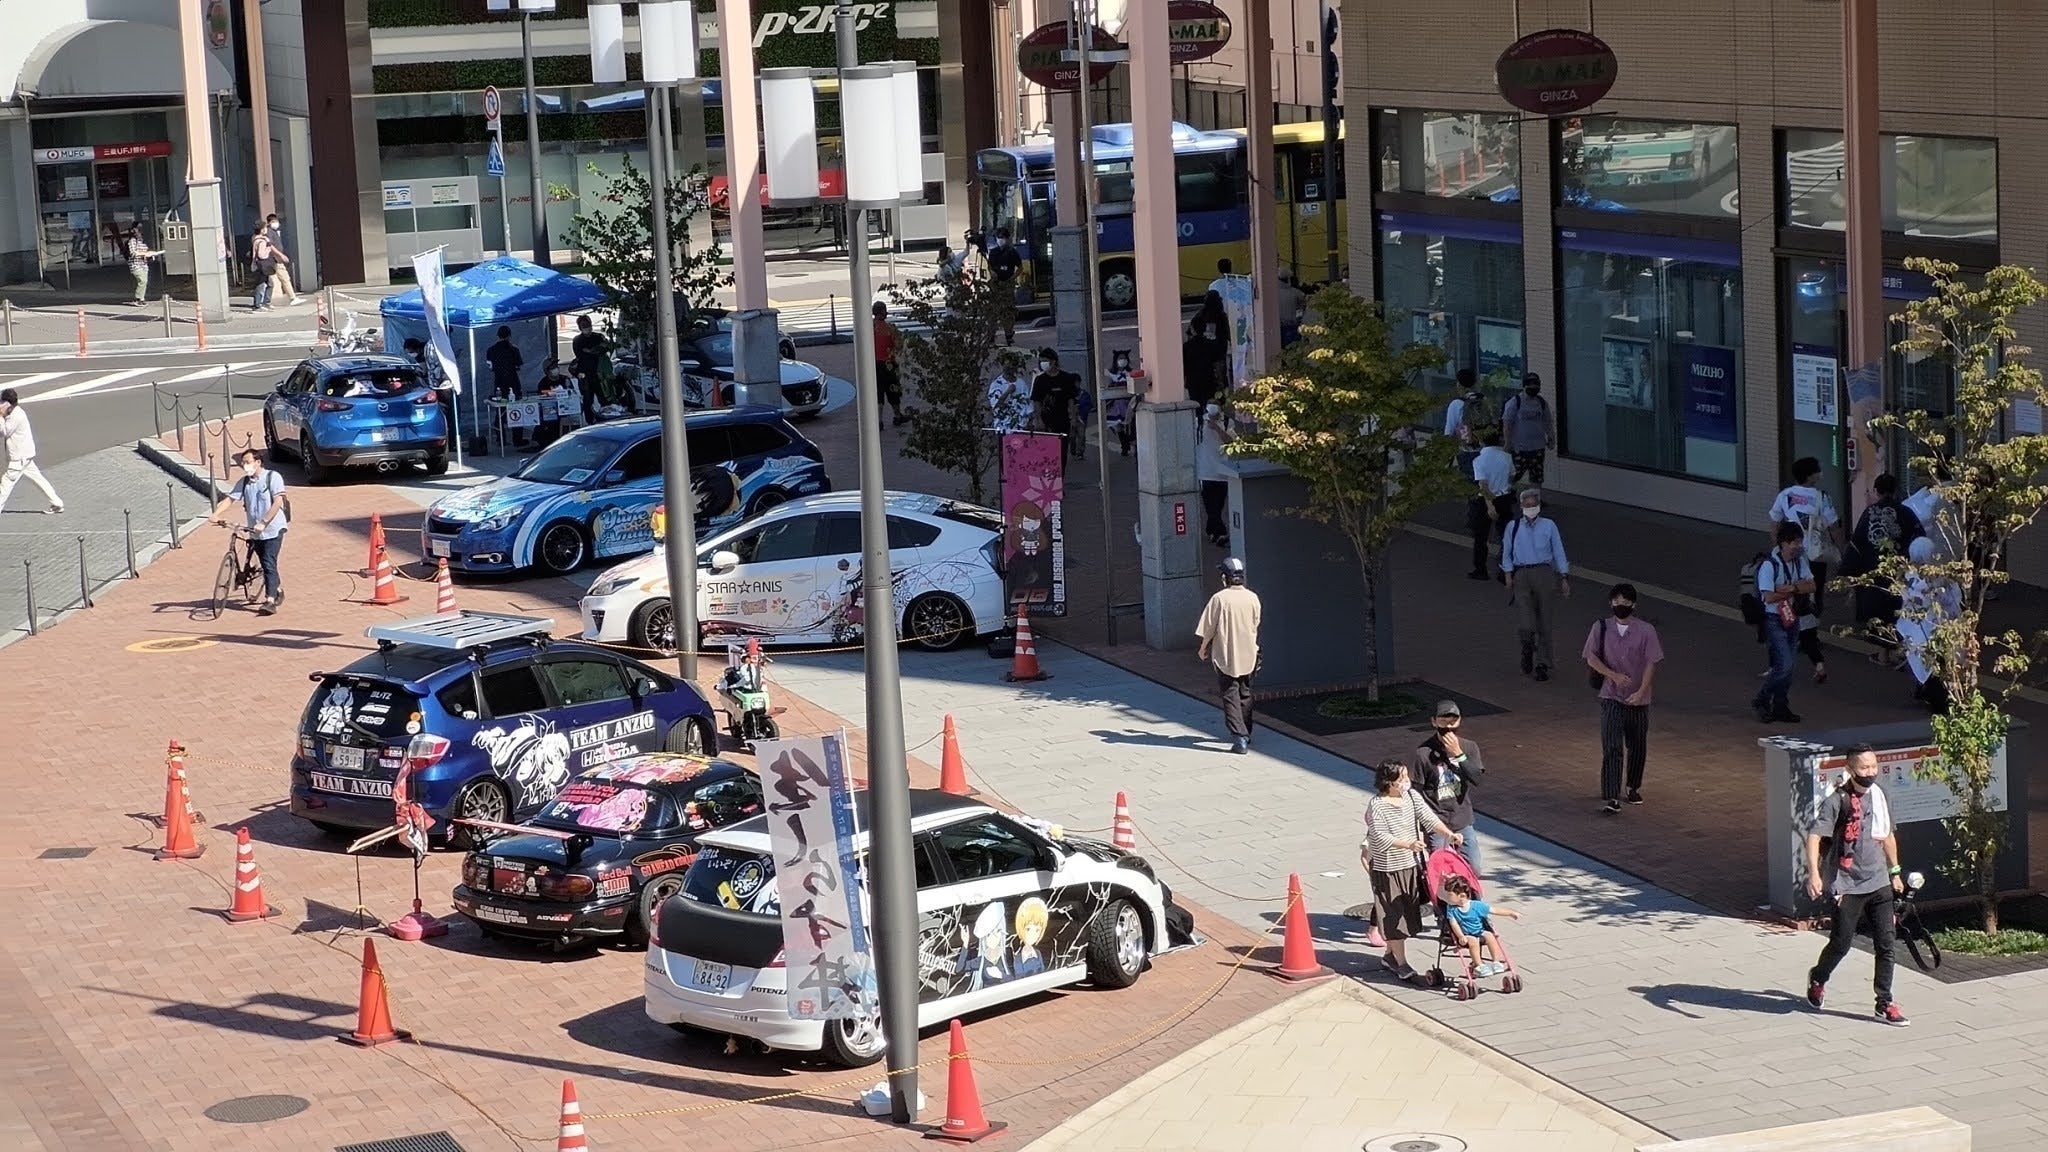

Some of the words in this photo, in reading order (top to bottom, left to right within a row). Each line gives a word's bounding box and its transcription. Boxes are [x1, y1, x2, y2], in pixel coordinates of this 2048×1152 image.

[1169, 43, 1199, 53] GINZA
[1054, 70, 1081, 81] GINZ
[1540, 89, 1578, 102] GINZA
[61, 150, 85, 158] MUFG
[1691, 363, 1725, 379] MIZUHO
[570, 725, 608, 748] TEAM
[614, 714, 655, 738] ANZIO
[312, 774, 345, 791] TEAM
[350, 780, 393, 796] ANZIO
[597, 868, 616, 881] Red
[616, 865, 633, 878] Bull
[604, 877, 629, 891] JDM
[536, 914, 569, 922] ADVAN
[700, 971, 728, 989] 84-92
